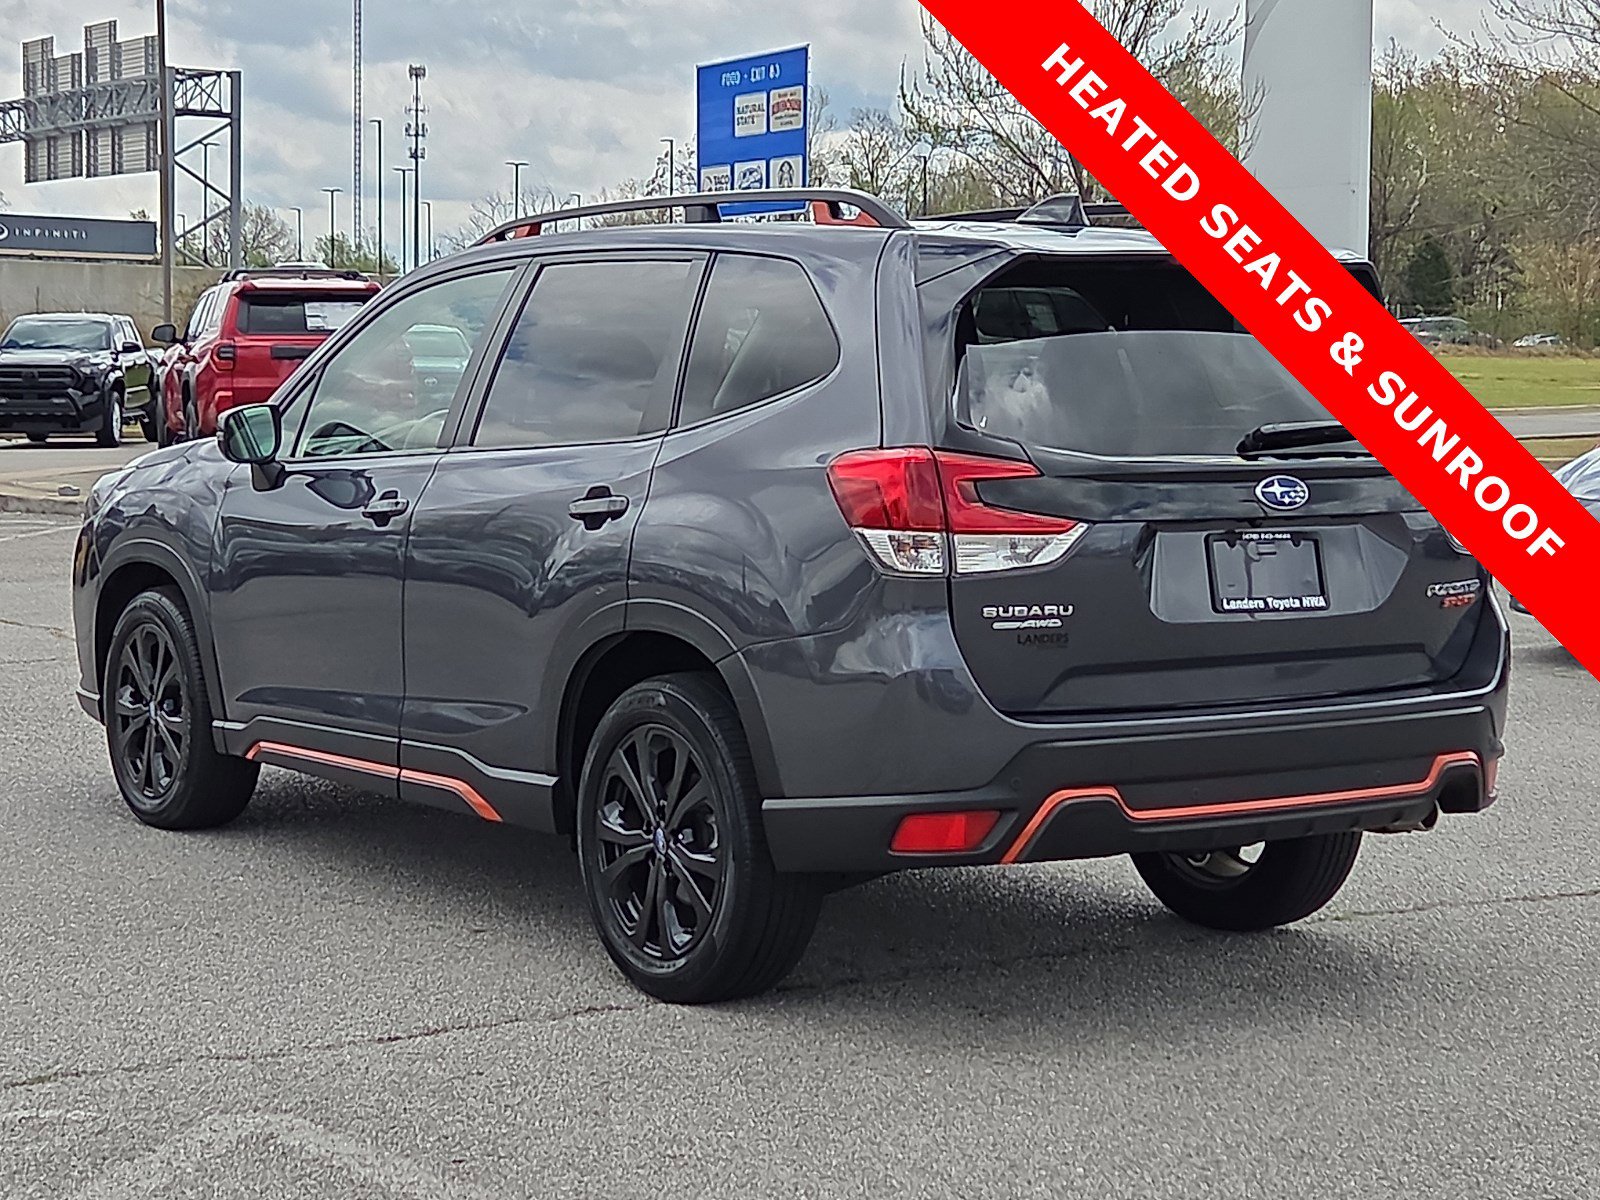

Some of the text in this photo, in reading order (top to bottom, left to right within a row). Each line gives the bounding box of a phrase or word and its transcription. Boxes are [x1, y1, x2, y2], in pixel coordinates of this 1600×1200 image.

[736, 103, 765, 114] NATURAL
[736, 114, 756, 126] STATE
[714, 174, 729, 185] TACO
[13, 227, 88, 239] INFINITI
[1222, 597, 1265, 610] Landers
[1266, 597, 1300, 611] Toyota
[982, 604, 1074, 618] SUBARU
[1020, 618, 1063, 629] AWD
[1016, 632, 1070, 645] LANDERS
